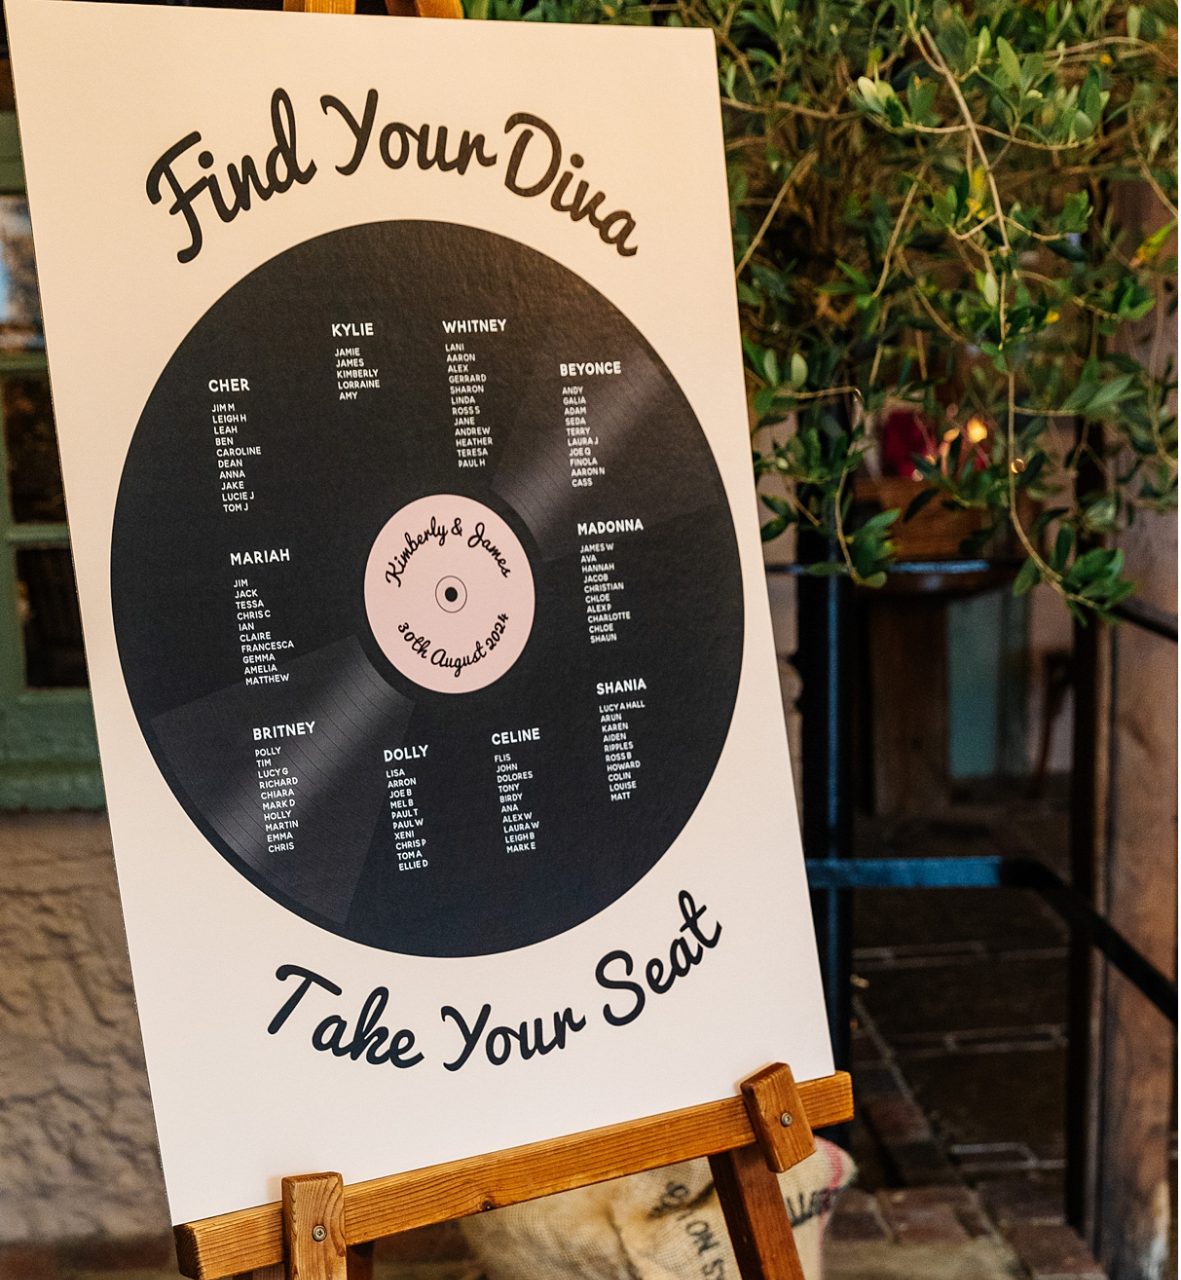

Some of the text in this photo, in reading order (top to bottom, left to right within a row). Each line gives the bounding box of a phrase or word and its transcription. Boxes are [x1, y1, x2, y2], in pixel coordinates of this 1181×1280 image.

[145, 86, 640, 265] Find Your Diva
[331, 322, 374, 337] KYLIE
[442, 318, 507, 334] WHITNEY
[334, 347, 360, 357] JAMIE
[445, 343, 465, 352] LANI
[336, 358, 365, 368] JAMES
[446, 353, 476, 362] AARON
[336, 369, 379, 379] KIMBERLY
[447, 364, 468, 373] ALEX
[559, 361, 622, 377] BEYONCE
[448, 373, 487, 384] GERRARD
[208, 378, 250, 392] CHER
[337, 379, 380, 390] LORRAINE
[450, 384, 484, 395] SHARON
[339, 391, 358, 400] AMY
[562, 386, 583, 395] ANDY
[450, 396, 476, 405] LINDA
[563, 396, 586, 405] GALIA
[211, 403, 235, 413] JIM M
[452, 406, 474, 415] ROSS
[564, 406, 587, 416] ADAM
[212, 414, 247, 424] LEIGH H
[454, 416, 475, 426] JANE
[565, 417, 586, 426] SEDA
[213, 425, 238, 435] LEAH
[454, 426, 491, 436] ANDREW
[566, 426, 591, 436] TERRY
[215, 437, 234, 446] BEN
[455, 436, 493, 447] HEATHER
[567, 437, 594, 447] LAURA
[216, 446, 262, 457] CAROLINE
[456, 447, 489, 458] TERESA
[569, 447, 584, 457] JOE
[217, 459, 243, 469] DEAN
[458, 458, 486, 468] PAUL H
[569, 457, 598, 467] FINOLA
[219, 470, 246, 479] ANNA
[571, 467, 599, 477] AARON
[221, 480, 245, 491] JAKE
[571, 477, 593, 488] CASS
[221, 491, 248, 502] LUCIE
[223, 503, 243, 512] TOM
[577, 518, 644, 536] MADONNA
[384, 515, 512, 589] Kimberly & James
[580, 543, 614, 554] JAMES W
[230, 548, 290, 566] MARIAH
[580, 554, 597, 563] AVA
[581, 563, 615, 573] HANNAH
[233, 578, 249, 588] JIM
[583, 573, 609, 584] JACOB
[583, 582, 625, 594] CHRISTIAN
[234, 589, 258, 599] JACK
[585, 593, 610, 604] CHLOE
[235, 599, 265, 610] TESSA
[586, 603, 612, 613] ALEX P
[236, 609, 271, 621] CHRIS C
[587, 610, 631, 624] CHARLOTTE
[238, 622, 255, 631] IAN
[588, 623, 614, 634] CHLOE
[239, 631, 271, 643] CLAIRE
[590, 633, 617, 644] SHAUN
[241, 640, 295, 653] FRANCESCA
[396, 612, 510, 679] 30th August 2024
[242, 653, 276, 664] GEMMA
[244, 664, 278, 675] AMELIA
[245, 673, 290, 686] MATTHEW
[596, 678, 647, 695] SHANIA
[599, 700, 646, 713] LUCY A HALL
[600, 713, 622, 723] ARUN
[252, 721, 315, 741] BRITNEY
[601, 722, 629, 733] KAREN
[491, 727, 540, 745] CELINE
[603, 732, 627, 743] AIDEN
[254, 746, 281, 757] POLLY
[604, 741, 634, 752] RIPPLES
[383, 744, 429, 762] DOLLY
[494, 753, 511, 763] FLIS
[605, 752, 626, 762] ROSS
[256, 758, 272, 768] TIM
[496, 763, 518, 773] JOHN
[606, 760, 641, 772] HOWARD
[257, 767, 289, 779] LUCY G
[385, 768, 406, 778] LISA
[496, 770, 533, 783] DOLORES
[607, 771, 632, 782] COLIN
[259, 776, 298, 789] RICHARD
[387, 777, 417, 788] ARRON
[498, 783, 520, 793] TONY
[609, 780, 637, 792] LOUISE
[260, 788, 295, 800] CHIARA
[389, 788, 412, 799] JOE B
[499, 792, 523, 803] BIRDY
[610, 791, 631, 801] MATT
[262, 798, 296, 811] MARK D
[390, 798, 414, 809] MEL B
[501, 803, 519, 813] ANA
[263, 810, 292, 821] HOLLY
[391, 808, 418, 819] PAUL T
[502, 812, 532, 823] ALEX W
[265, 819, 299, 832] MARTIN
[392, 818, 424, 830] PAUL W
[503, 821, 540, 834] LAURA W
[267, 831, 294, 843] EMMA
[394, 830, 415, 840] XENI
[504, 833, 529, 844] LEIGH
[268, 841, 295, 853] CHRIS
[395, 838, 427, 850] CHRIS P
[506, 841, 536, 854] MARK E
[396, 850, 423, 861] TOM A
[398, 859, 429, 871] ELLIE D
[266, 888, 724, 1073] Take Your Seat
